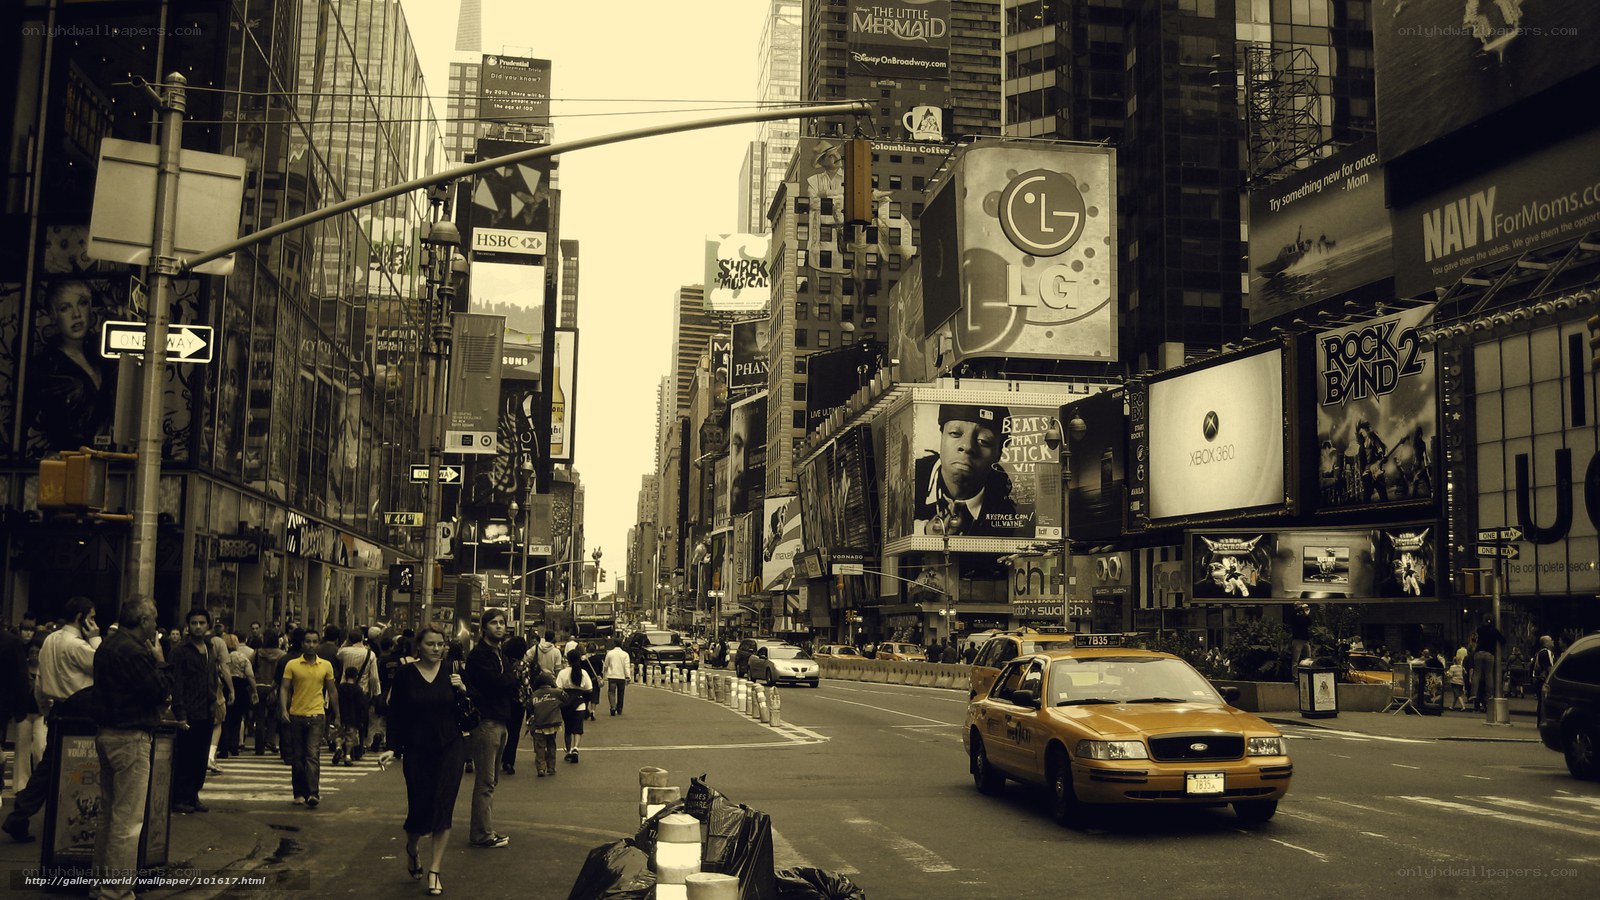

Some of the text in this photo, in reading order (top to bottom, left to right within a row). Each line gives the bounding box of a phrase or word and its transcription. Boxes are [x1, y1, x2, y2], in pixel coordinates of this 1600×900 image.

[872, 6, 928, 20] THE LITTLE
[852, 12, 947, 42] MERMAID
[499, 59, 529, 67] Prudential
[920, 146, 950, 154] Coffee
[1269, 153, 1378, 212] Try something new for once.
[477, 233, 519, 249] HSBC
[1431, 265, 1443, 276] You
[1444, 261, 1459, 275] gave
[1459, 255, 1475, 268] them
[1476, 250, 1487, 262] the
[1511, 238, 1523, 250] We
[1524, 232, 1540, 247] give
[1540, 225, 1559, 240] them
[1560, 220, 1574, 233] the
[718, 258, 769, 279] SHREK
[720, 273, 769, 290] MUSICAL
[1006, 263, 1076, 310] LG
[120, 334, 195, 349] ONE WAY
[1320, 318, 1400, 376] ROCK
[502, 356, 529, 366] SUNG
[735, 361, 770, 376] PHAN
[1321, 326, 1426, 409] BAND 2
[1001, 417, 1050, 434] BEATS
[1009, 433, 1043, 447] THAT
[1001, 445, 1053, 463] STICK
[1190, 444, 1235, 467] XBOX 360
[384, 514, 392, 525] W
[394, 514, 407, 524] 44
[1504, 530, 1518, 538] WAY
[1087, 636, 1108, 645] 7B35
